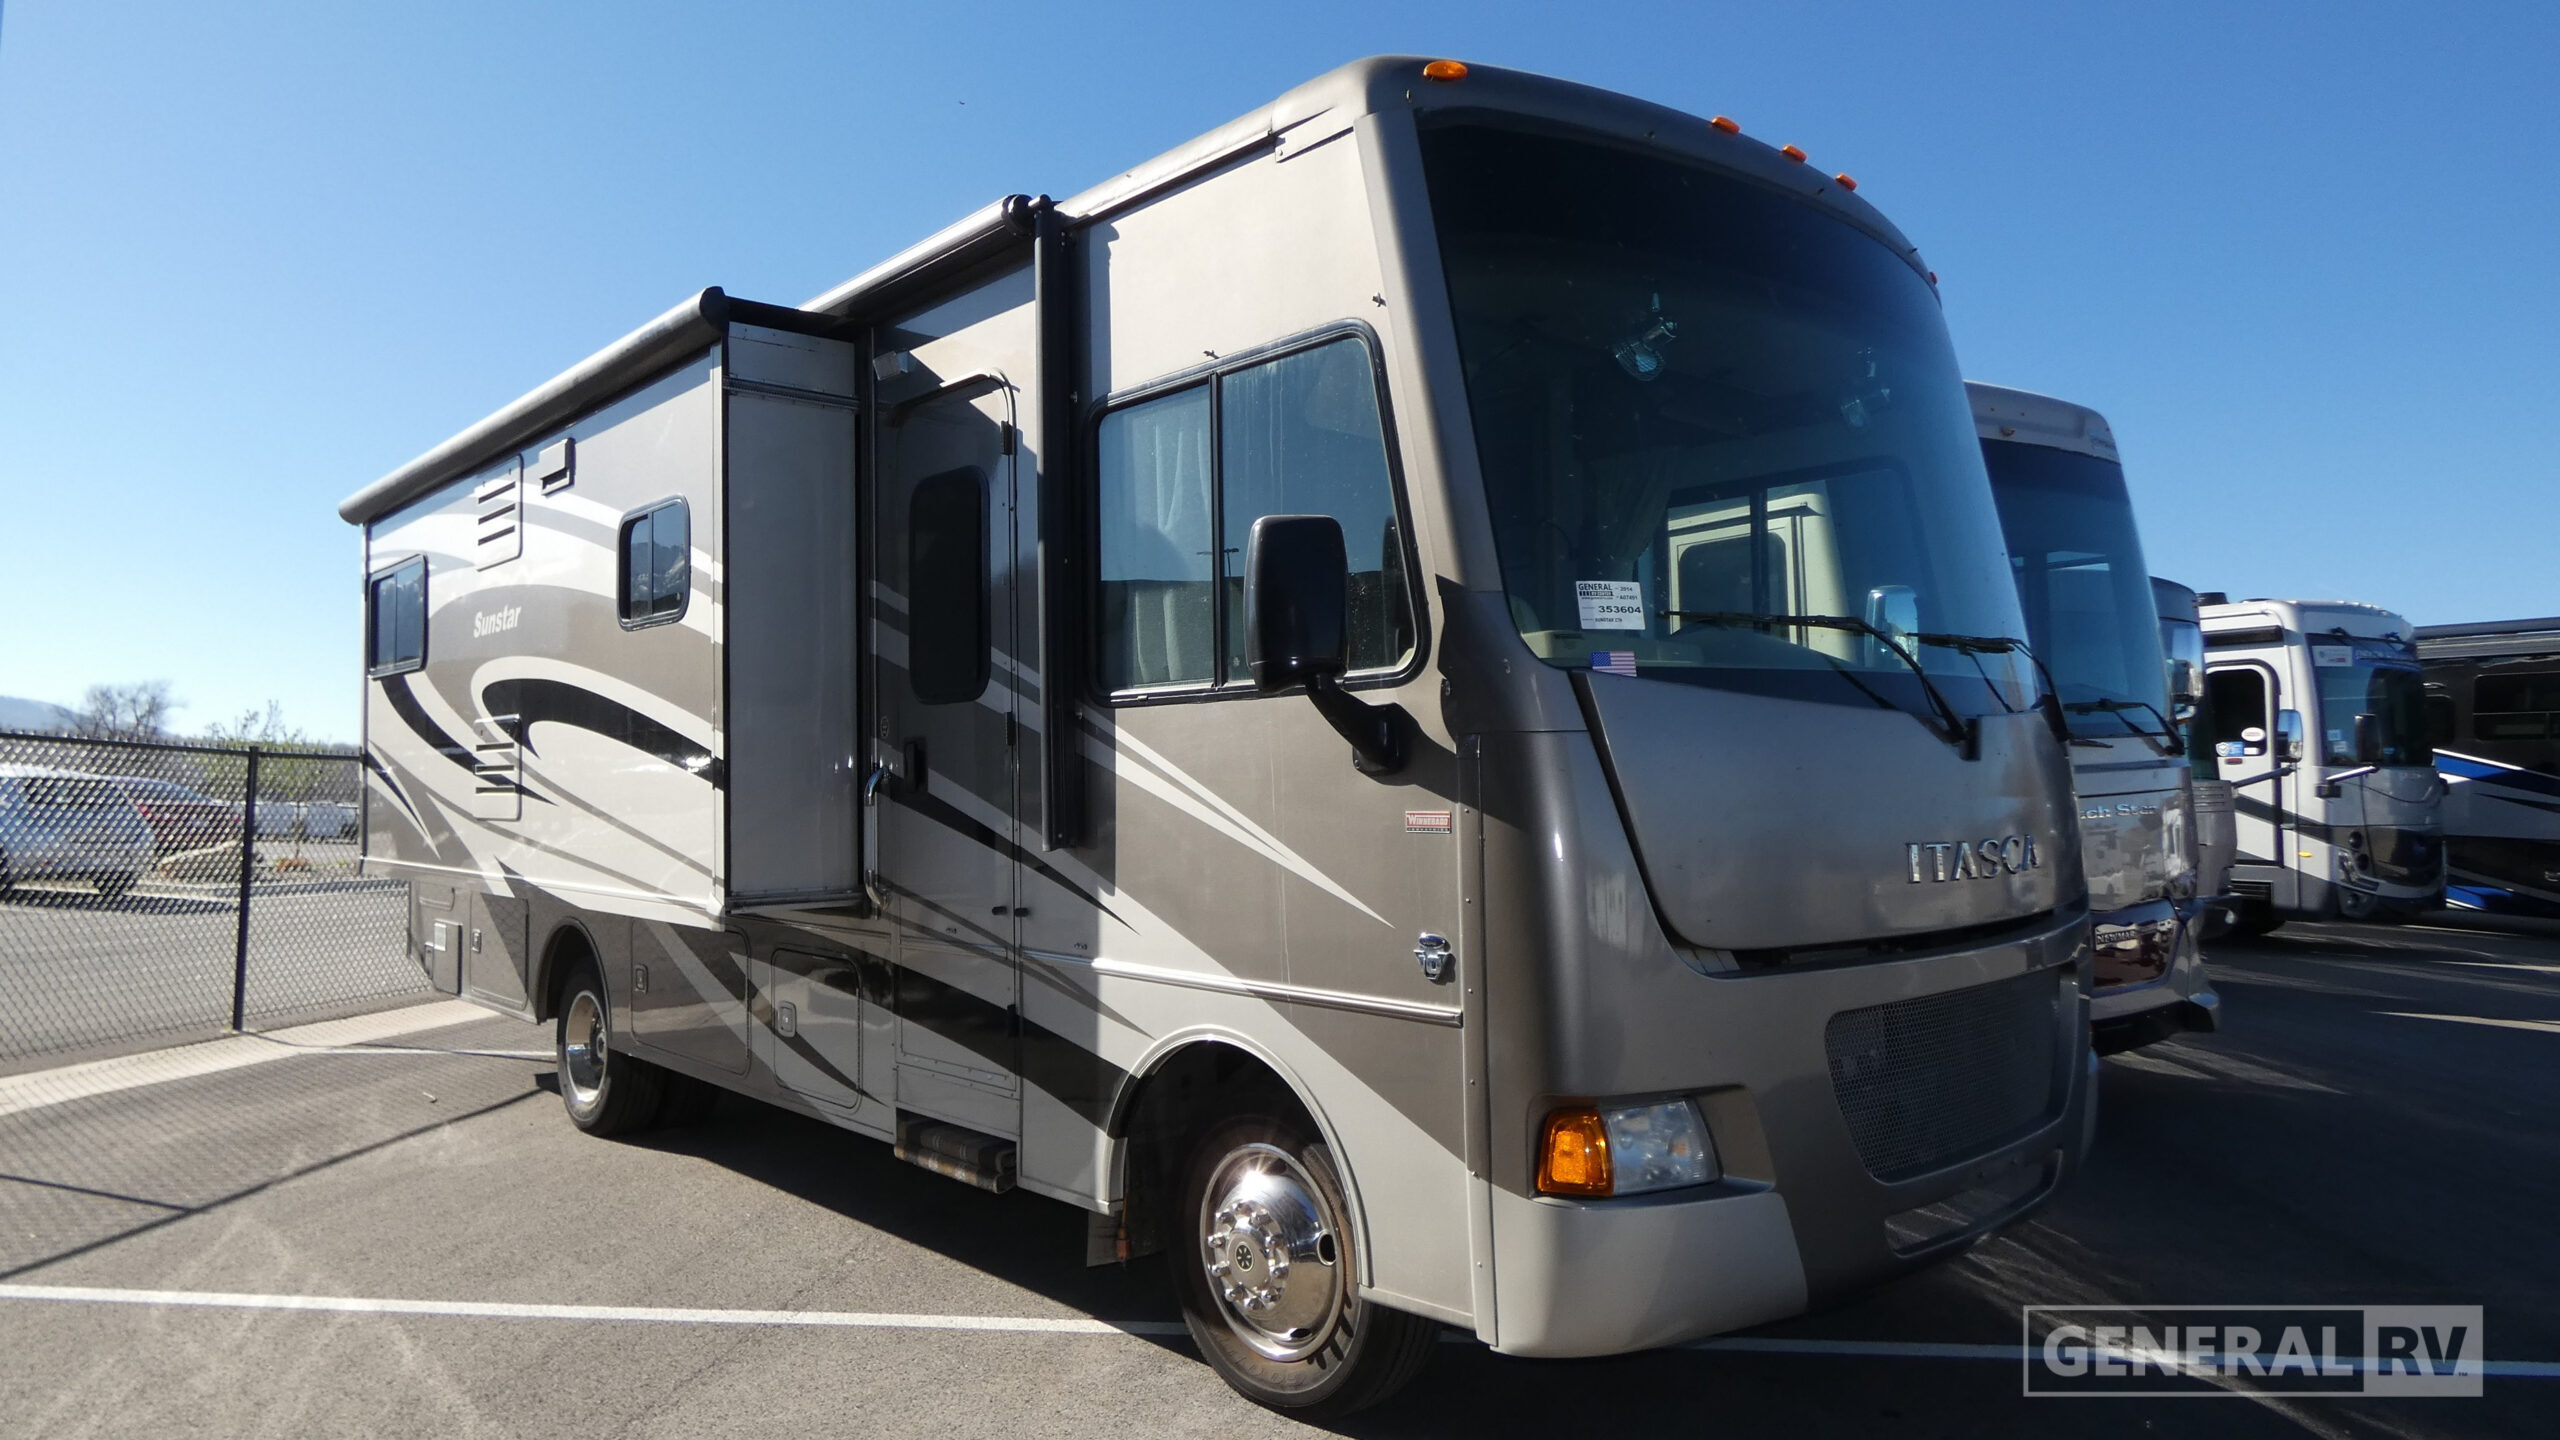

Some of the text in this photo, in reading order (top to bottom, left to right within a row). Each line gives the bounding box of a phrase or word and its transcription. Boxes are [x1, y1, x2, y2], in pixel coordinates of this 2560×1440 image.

[473, 604, 522, 638] Sunstar
[1598, 605, 1641, 613] 353604
[1905, 833, 2040, 884] ITASCA
